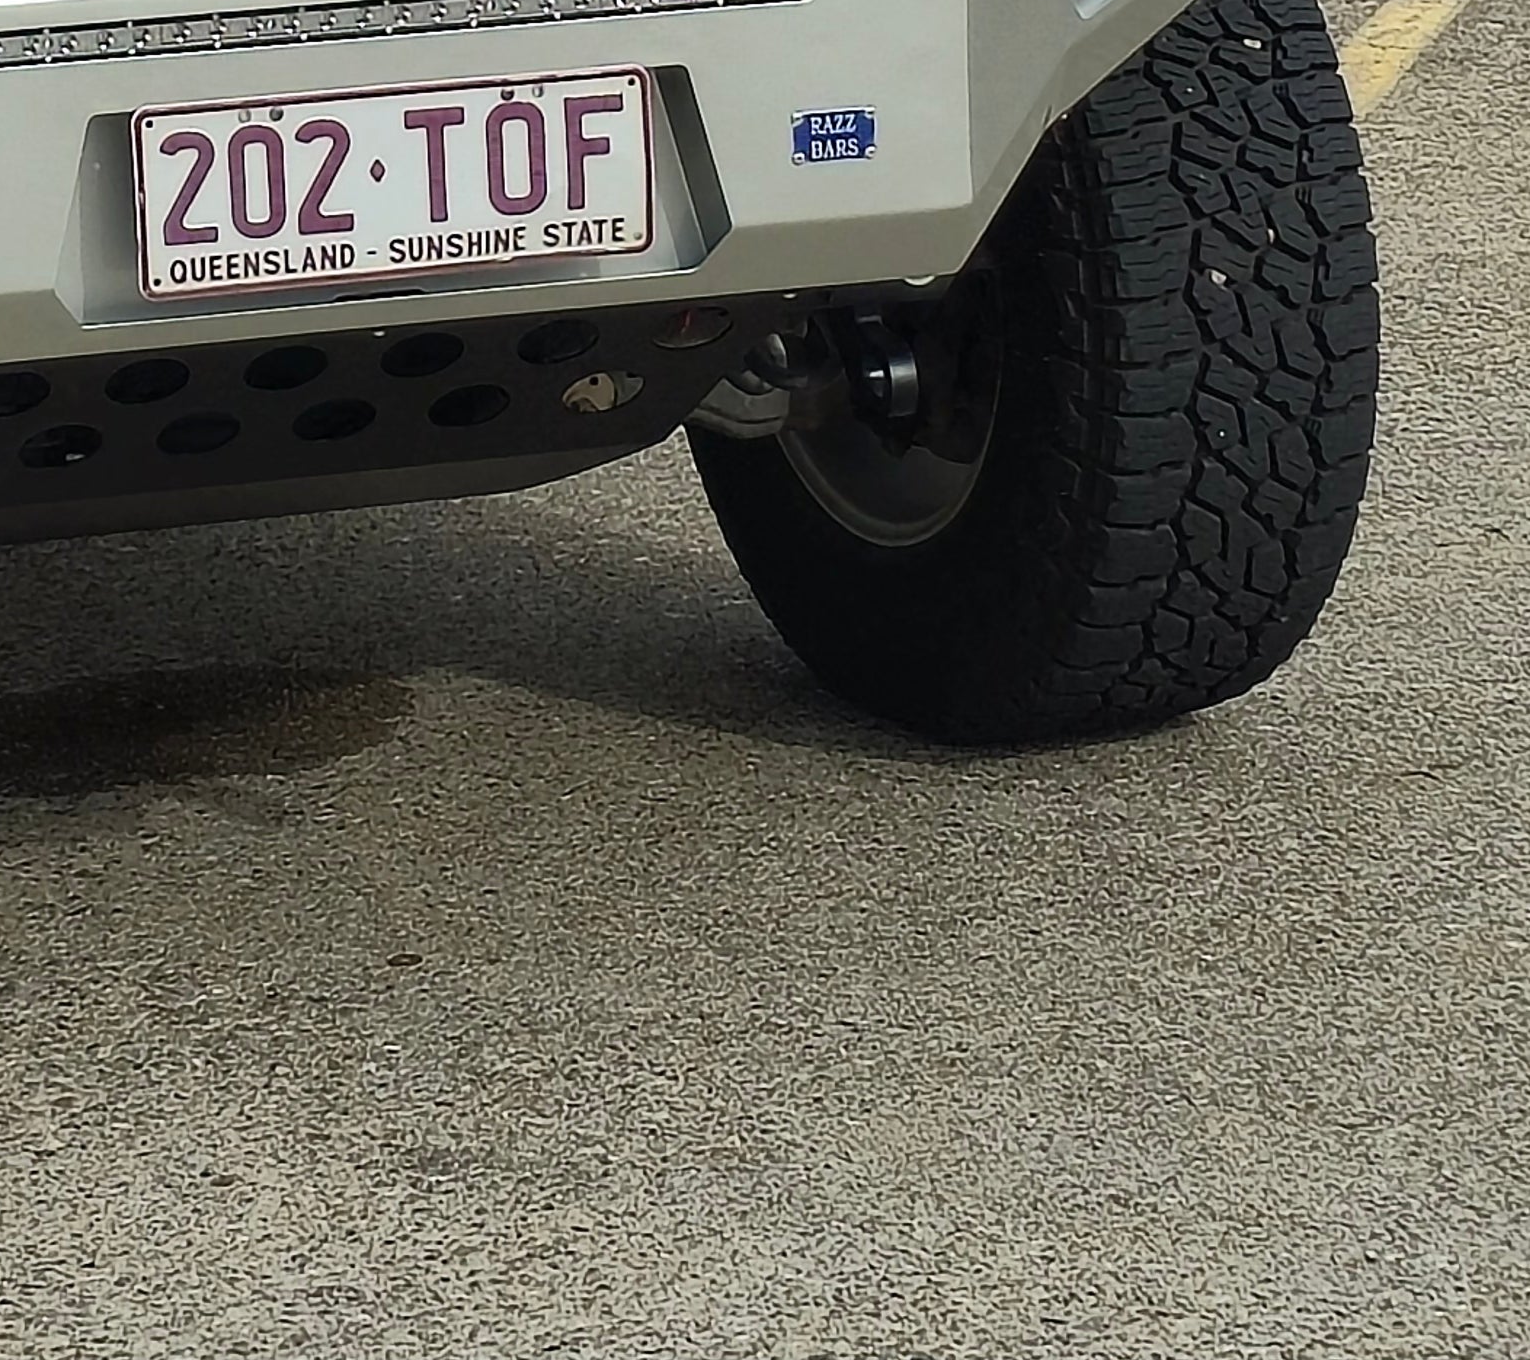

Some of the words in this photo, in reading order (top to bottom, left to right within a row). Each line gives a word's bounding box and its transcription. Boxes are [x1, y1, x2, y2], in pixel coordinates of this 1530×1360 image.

[810, 114, 857, 135] RAZZ
[811, 138, 859, 159] BARS
[170, 242, 356, 285] QUEENSLAND
[389, 225, 527, 264] SUNSHINE
[543, 217, 626, 247] STATE
